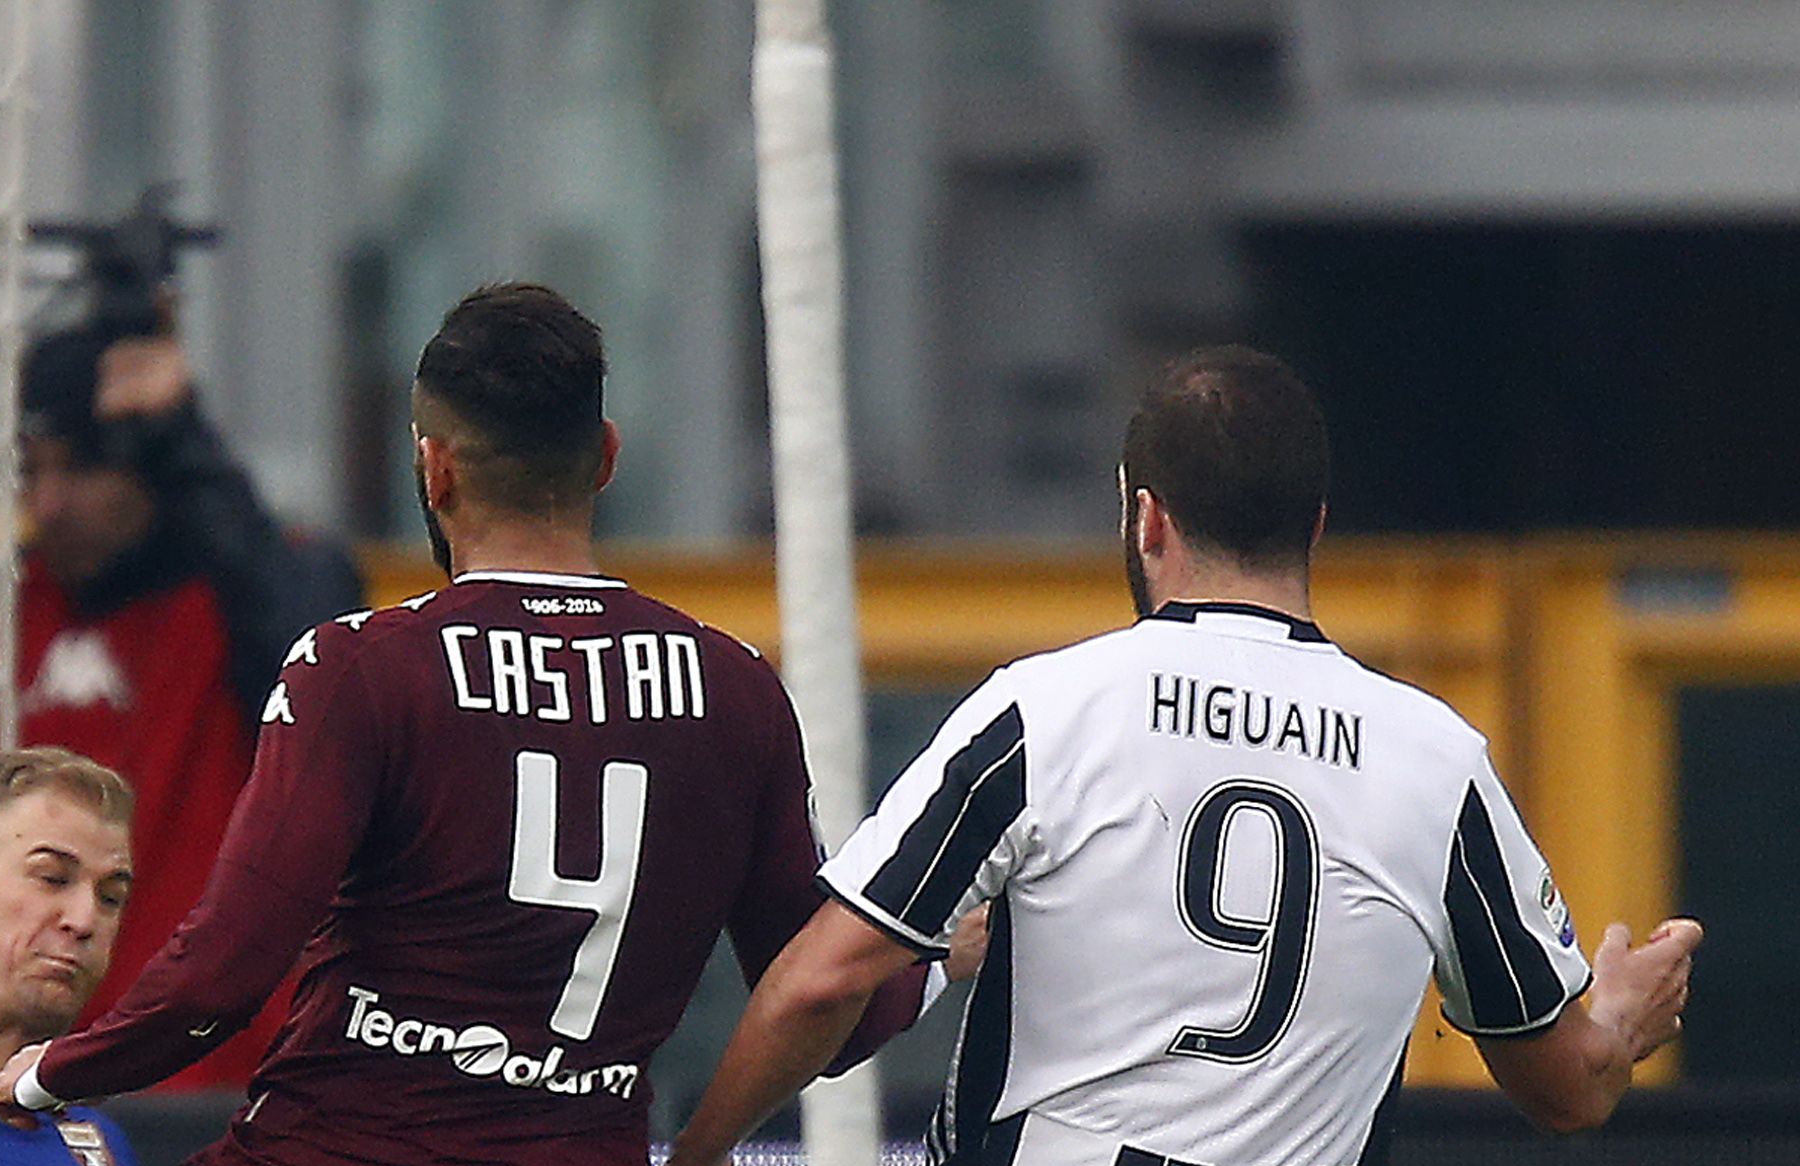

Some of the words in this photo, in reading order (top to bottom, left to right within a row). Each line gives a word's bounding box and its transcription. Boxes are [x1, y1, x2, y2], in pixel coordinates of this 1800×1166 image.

[443, 626, 704, 722] CASTAN
[1151, 673, 1362, 769] HIGUAIN
[509, 751, 648, 1040] 4
[1166, 778, 1322, 1064] 9
